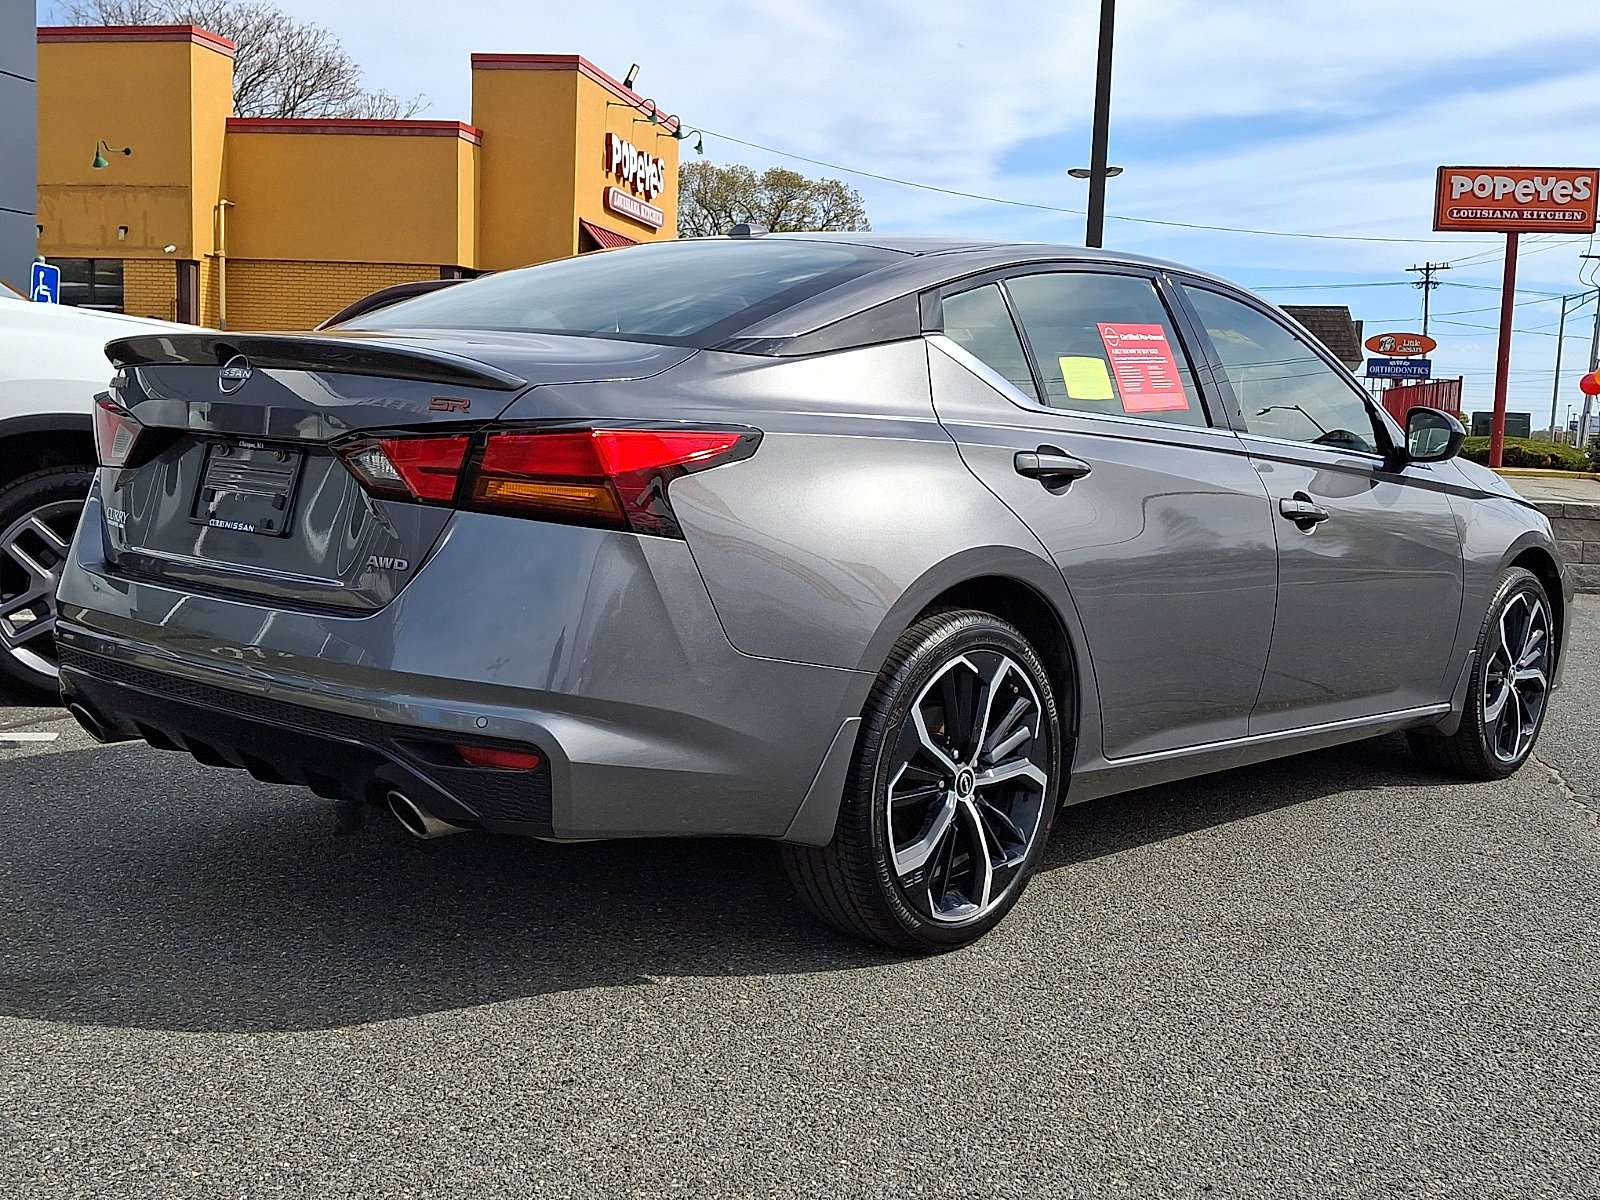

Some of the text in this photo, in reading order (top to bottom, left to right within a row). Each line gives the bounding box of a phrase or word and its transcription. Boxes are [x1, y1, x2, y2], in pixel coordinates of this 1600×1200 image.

[1452, 209, 1583, 220] LOUISIANA KITCHEN
[1397, 345, 1423, 353] Caesars
[1402, 339, 1421, 347] Little
[1369, 365, 1429, 375] ORTHODONTICS
[428, 396, 470, 414] SR
[106, 506, 130, 524] CURRY
[225, 521, 255, 532] NISSAN
[366, 555, 408, 571] AWD
[1022, 647, 1058, 726] BRIDGESTONE
[877, 855, 922, 928] BRIDGESTONE
